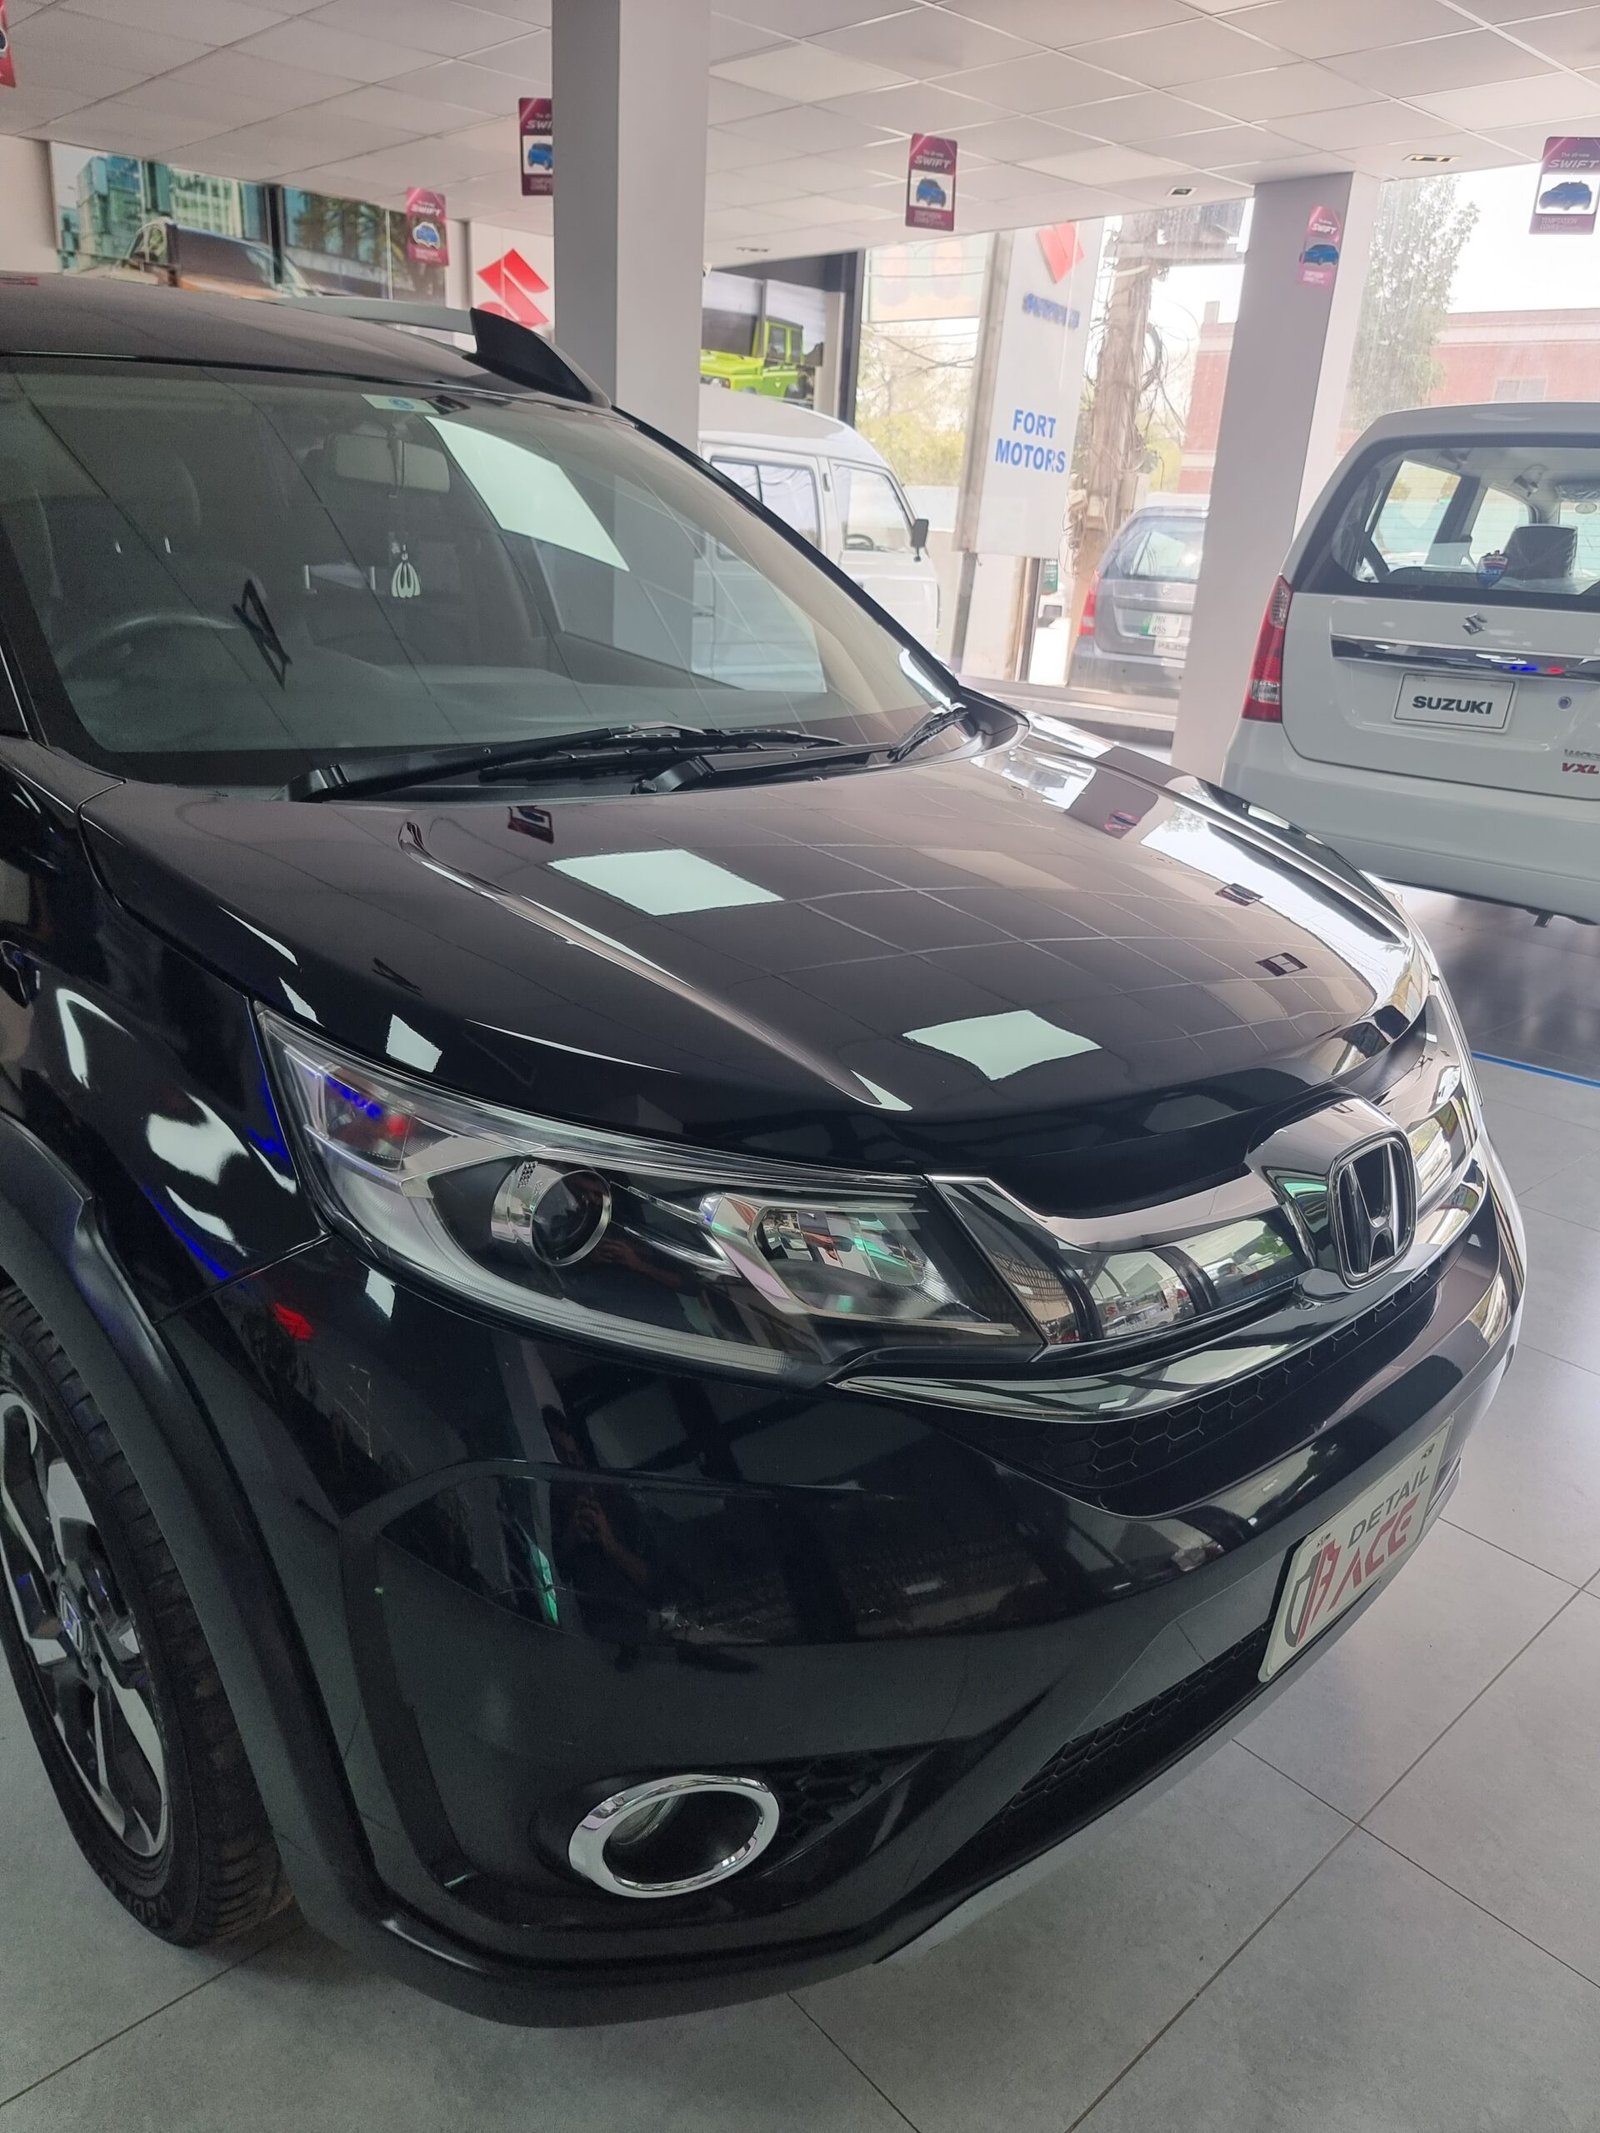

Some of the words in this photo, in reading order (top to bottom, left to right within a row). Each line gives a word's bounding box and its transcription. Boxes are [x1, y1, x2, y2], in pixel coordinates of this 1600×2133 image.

[915, 155, 952, 169] SWIFT
[1548, 159, 1600, 169] SWIFT
[1012, 409, 1056, 439] FORT
[995, 438, 1066, 474] MOTORS
[1412, 695, 1493, 716] SUZUKI
[1562, 762, 1600, 775] VXL
[1347, 1465, 1430, 1549] DETAIL
